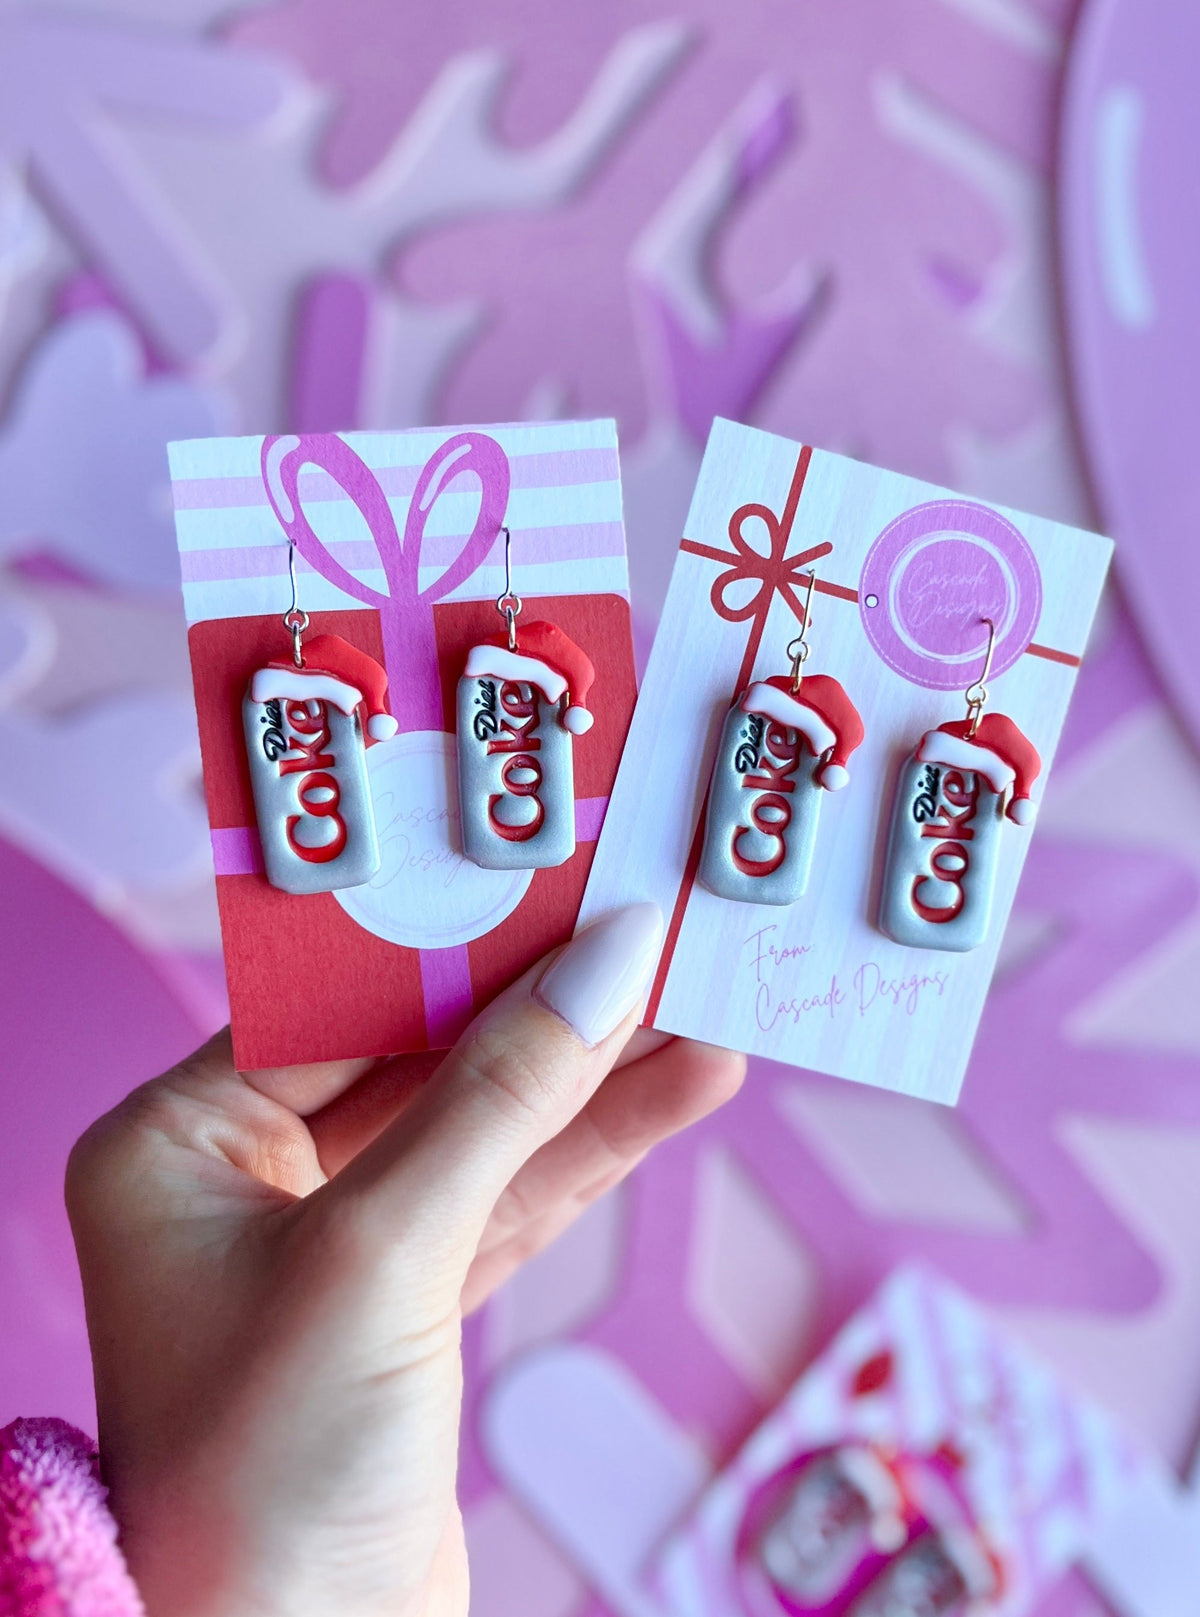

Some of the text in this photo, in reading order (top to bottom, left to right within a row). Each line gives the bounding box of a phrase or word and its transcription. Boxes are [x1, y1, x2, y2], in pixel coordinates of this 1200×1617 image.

[473, 679, 498, 742] Diet
[486, 680, 546, 843] Coke
[278, 698, 348, 864] Coke
[730, 721, 801, 878] Coke
[912, 764, 940, 823] Diet
[910, 770, 981, 924] Coke
[743, 924, 812, 983] From
[755, 962, 950, 1032] Cascade Designs
